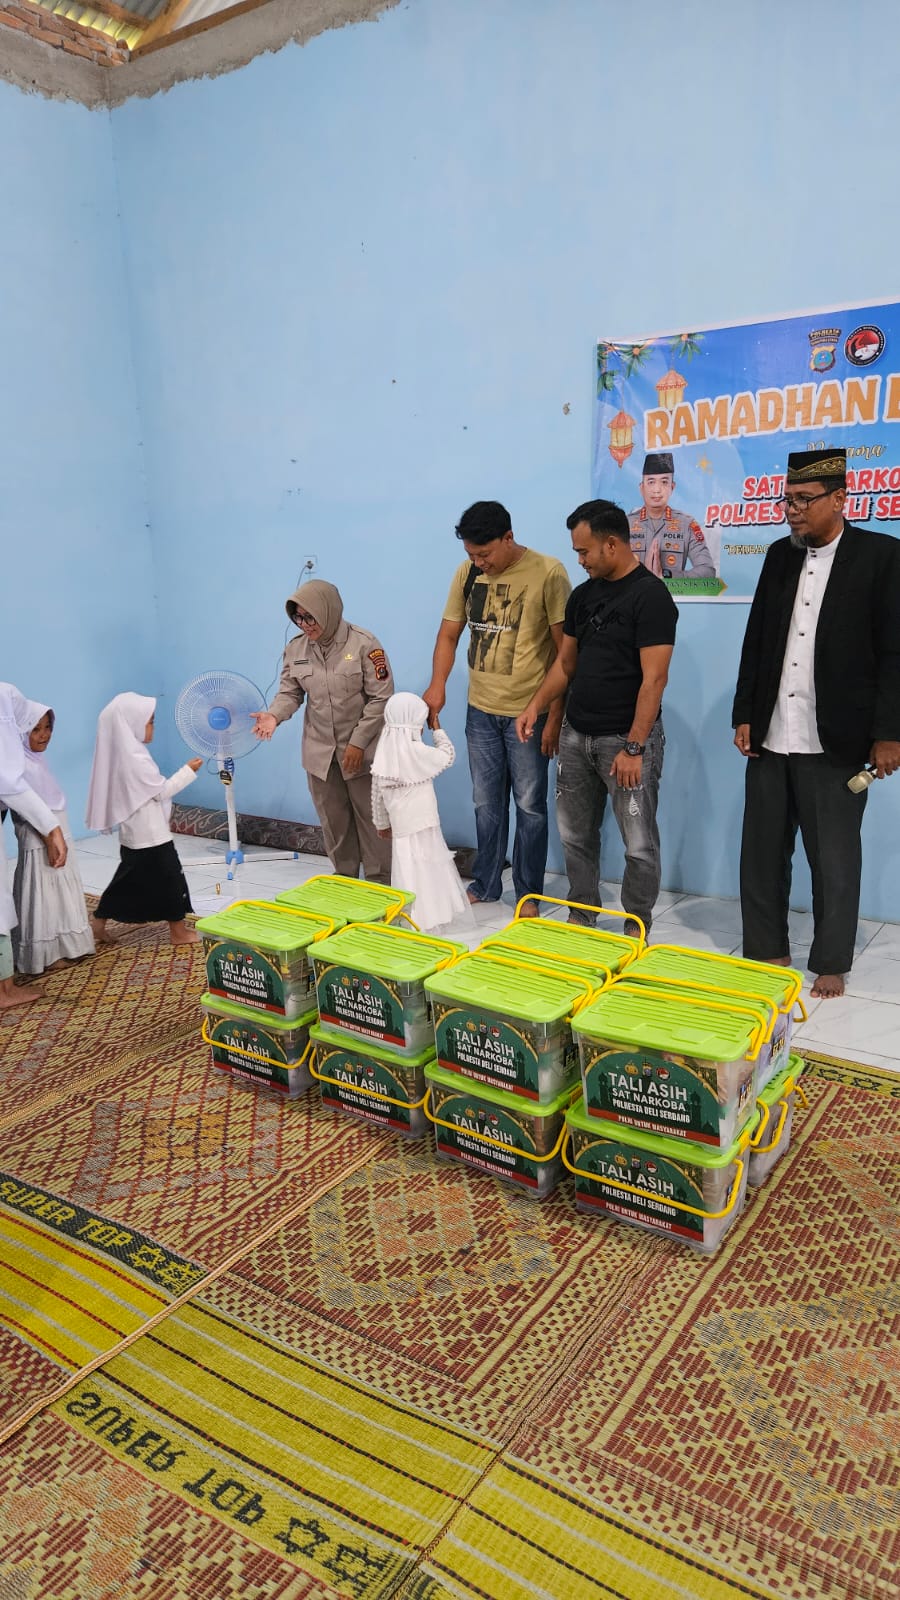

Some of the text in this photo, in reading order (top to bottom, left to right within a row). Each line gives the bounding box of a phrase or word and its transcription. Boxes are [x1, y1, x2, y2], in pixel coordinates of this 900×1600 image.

[645, 376, 881, 450] RAMADHAN
[219, 959, 265, 982] TALI ASIH
[222, 971, 265, 989] SAT NARKOBA
[330, 983, 383, 1009] TALI ASIH
[335, 996, 383, 1017] SAT NARKOBA
[223, 1035, 245, 1051] TALI
[247, 1045, 270, 1058] ASIH
[453, 1028, 515, 1058] TALI ASIH
[457, 1041, 514, 1067] SAT NARKOBA
[457, 1052, 517, 1079] POLRESTA DELI SERDANG
[334, 1068, 358, 1085] TALI
[360, 1079, 388, 1095] ASIH
[608, 1072, 688, 1102] TALI ASIH
[612, 1088, 686, 1112] SAT NARKOBA
[612, 1099, 690, 1124] POLRESTA DELI SERDANG
[452, 1113, 480, 1132] TALI
[483, 1126, 513, 1146] ASIH
[456, 1136, 481, 1152] POLRESTA
[480, 1146, 492, 1157] DELI
[598, 1160, 632, 1182] TALI
[636, 1173, 675, 1196] ASIH
[601, 1185, 632, 1202] POLRESTA
[632, 1193, 647, 1206] DELI
[647, 1198, 677, 1217] SERDANG
[1, 1181, 133, 1248] SUPER TOP
